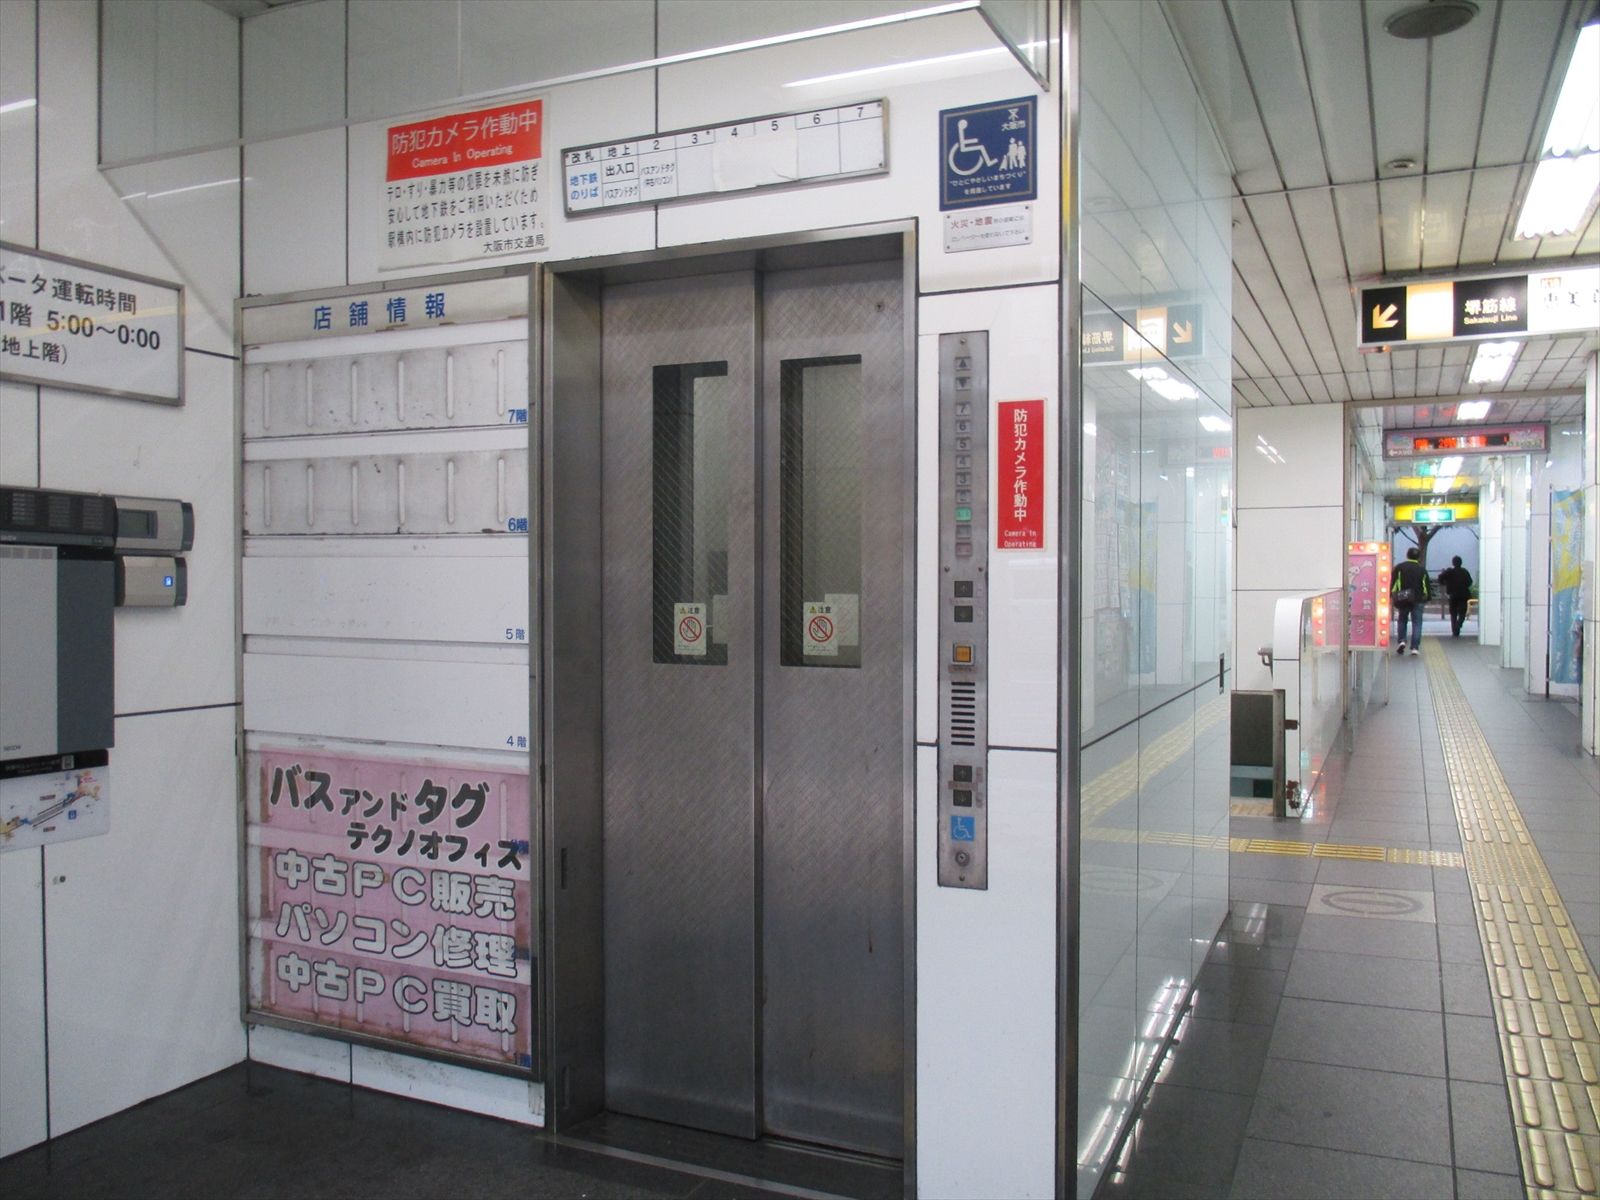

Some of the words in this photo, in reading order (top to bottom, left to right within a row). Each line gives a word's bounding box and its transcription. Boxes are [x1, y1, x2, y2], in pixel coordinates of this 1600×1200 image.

[391, 109, 538, 154] 防犯カメラ作動中
[571, 150, 594, 163] 改札
[607, 145, 631, 158] 地上
[652, 139, 660, 151] 2
[691, 133, 699, 145] 3
[731, 127, 738, 138] 4
[771, 120, 779, 132] 5
[812, 113, 821, 125] 6
[857, 106, 864, 118] 7
[411, 155, 449, 169] Camera
[466, 144, 513, 160] Operating
[570, 173, 598, 187] 地下鉄
[605, 162, 635, 177] 出入口
[570, 187, 599, 200] のりば
[388, 187, 538, 224] 安心して地下鉄をご利用いただくため
[483, 234, 545, 253] 大阪市交通局
[313, 293, 446, 331] 店舗情報
[1464, 296, 1517, 315] 堺筋線
[1500, 313, 1519, 321] Line
[507, 407, 528, 424] 7階
[1013, 408, 1028, 522] 防犯カメラ作動中
[507, 517, 528, 533] 6階
[1004, 529, 1026, 537] Camera
[505, 627, 525, 641] 5階
[506, 734, 527, 748] 4階
[269, 763, 491, 829] バスアンドタグ
[347, 822, 522, 871] テクノオフィス
[275, 848, 516, 921] 中古PC販売
[275, 902, 518, 978] パソコン修理
[276, 951, 517, 1034] 中古PC買取
